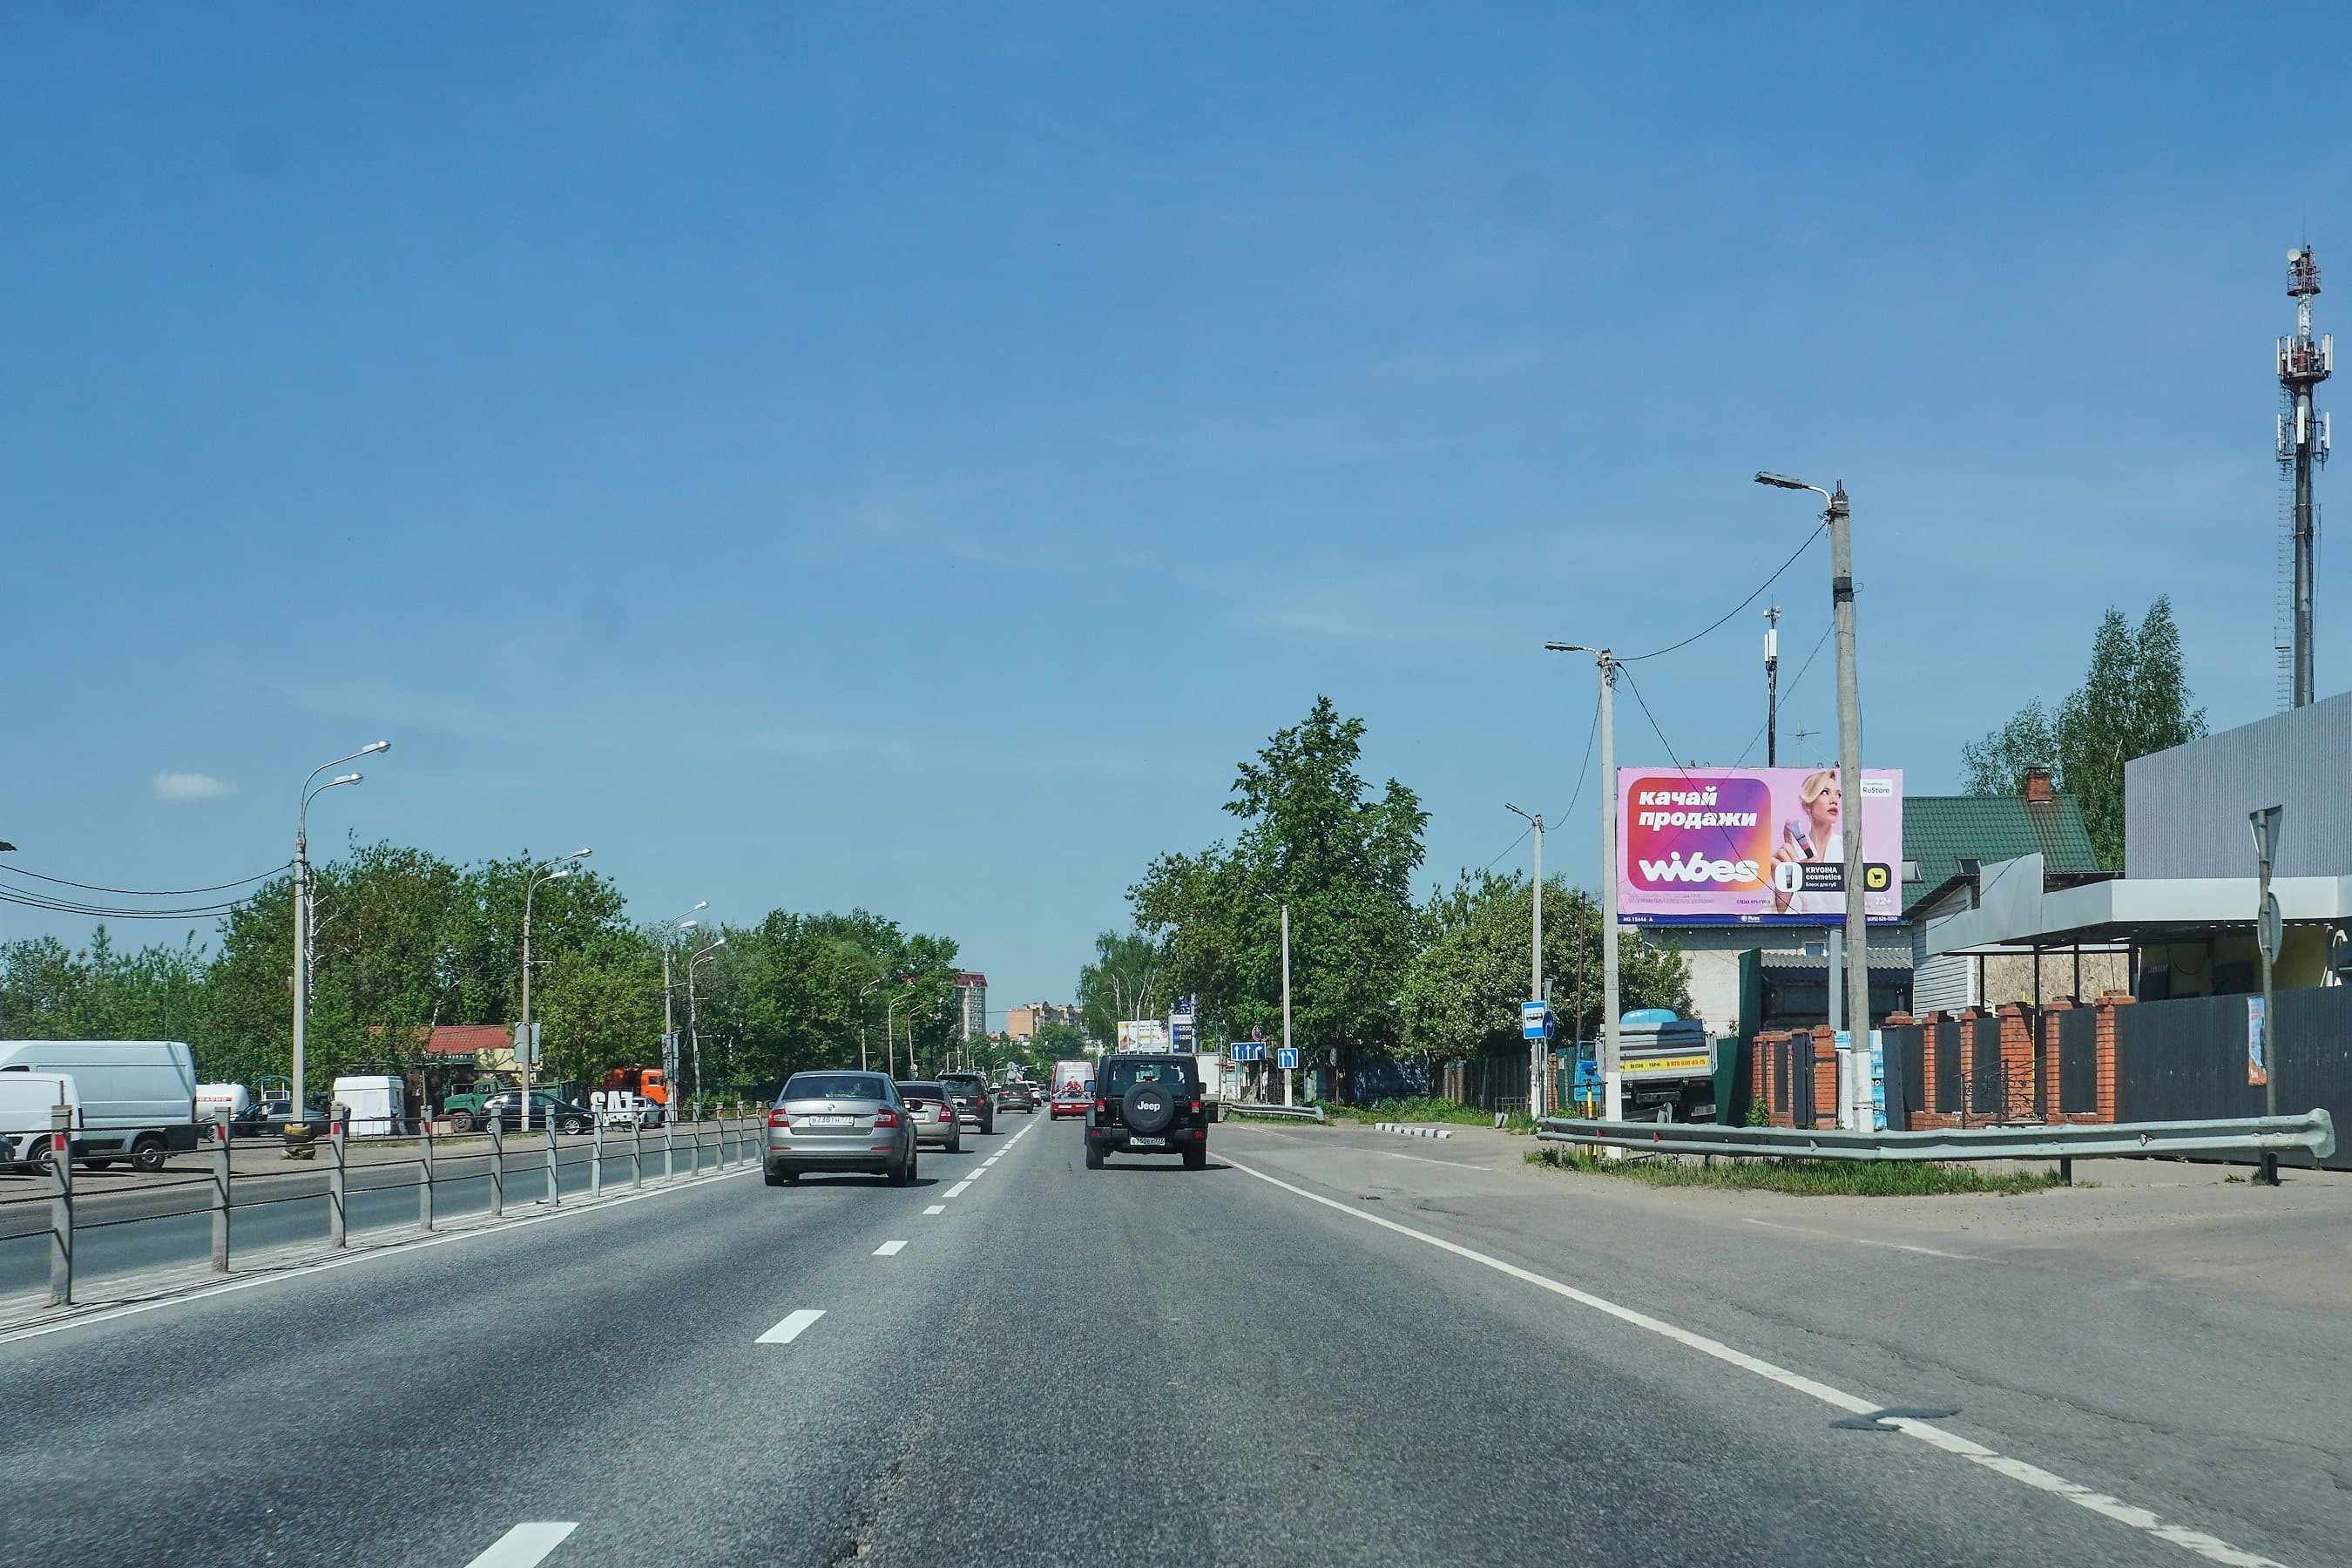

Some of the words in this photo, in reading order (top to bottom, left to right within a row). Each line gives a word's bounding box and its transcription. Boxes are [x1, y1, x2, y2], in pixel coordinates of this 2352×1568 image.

[1639, 786, 1718, 807] качай
[1638, 810, 1758, 832] продажи
[1638, 851, 1761, 883] wibes
[1137, 1100, 1160, 1112] Jeep
